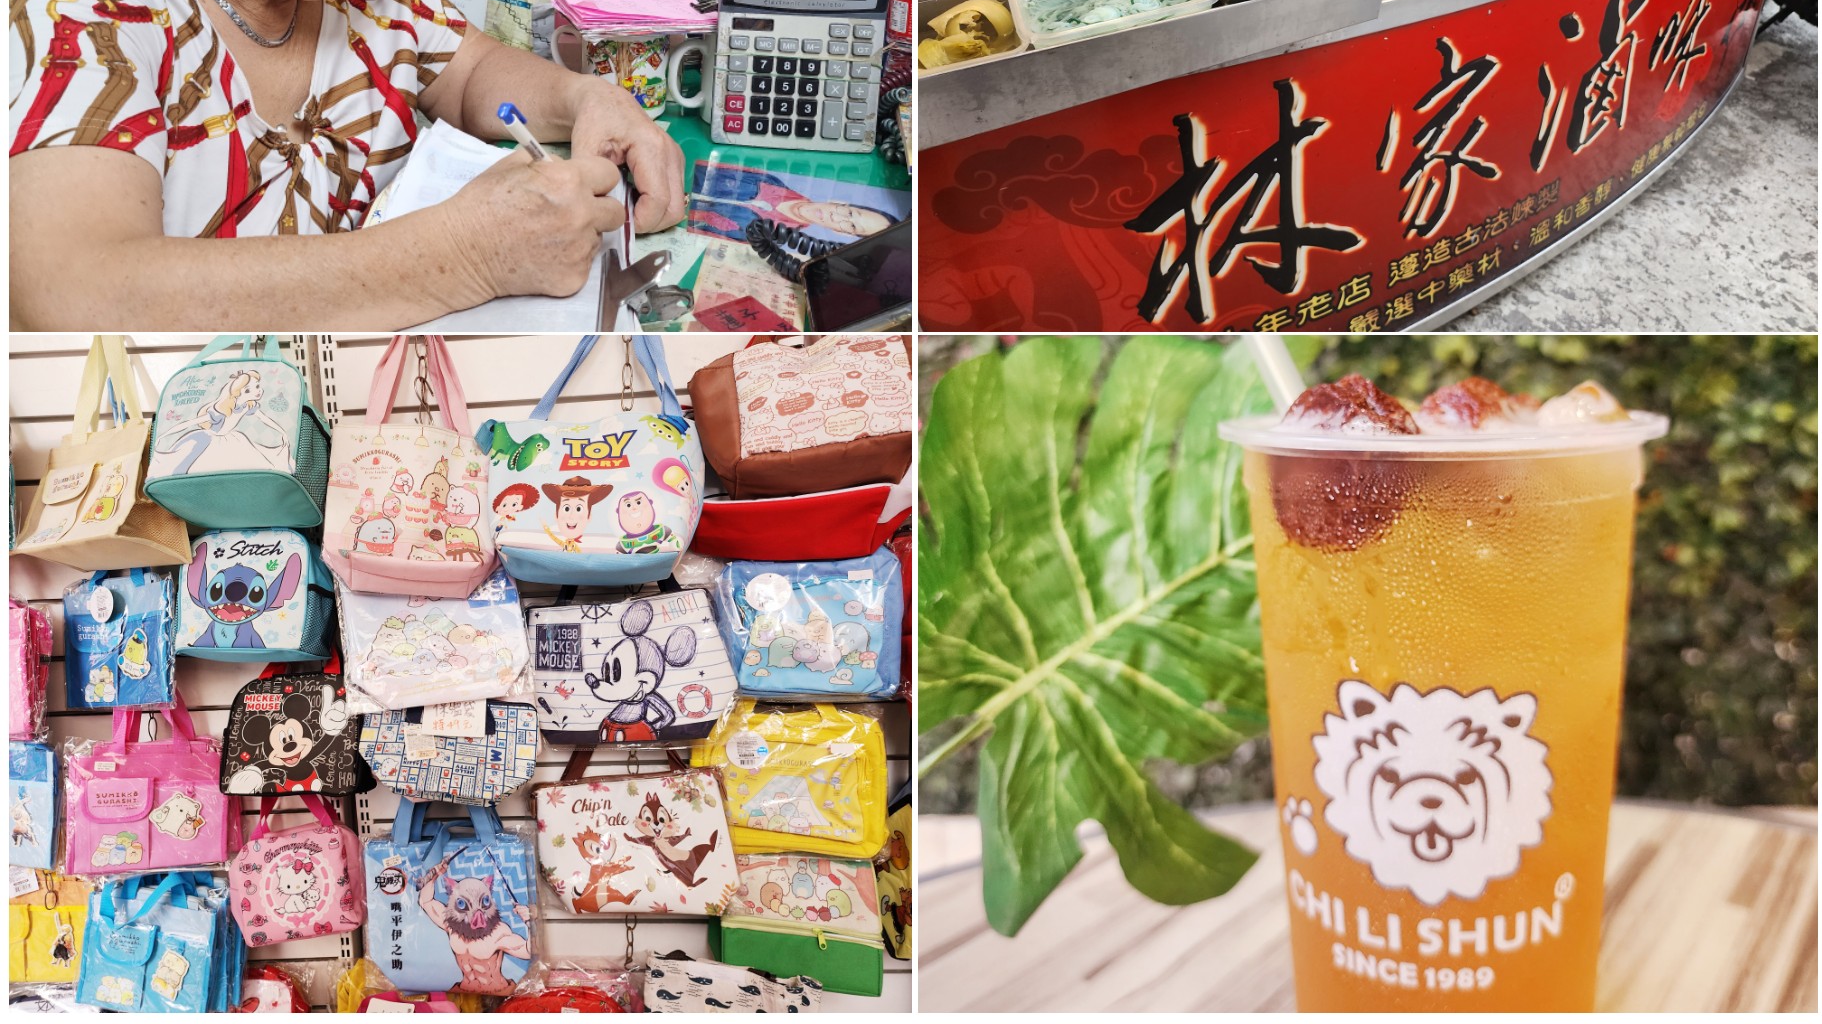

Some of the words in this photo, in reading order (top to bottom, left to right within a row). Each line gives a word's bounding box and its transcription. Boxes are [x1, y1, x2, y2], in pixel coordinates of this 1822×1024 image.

[759, 60, 768, 69] 7
[783, 62, 791, 71] 8
[808, 63, 816, 72] 9
[758, 81, 766, 90] 4
[782, 82, 790, 92] 5
[805, 83, 813, 93] 6
[729, 100, 743, 109] CE
[758, 101, 764, 111] 1
[780, 102, 788, 111] 2
[804, 104, 812, 114] 3
[727, 120, 741, 129] AC
[756, 122, 764, 131] 0
[776, 123, 789, 132] 00
[562, 429, 637, 459] TOY
[567, 458, 624, 468] STORY
[227, 540, 284, 559] Stitch
[661, 594, 700, 624] AHOY!
[557, 628, 578, 640] 1928
[538, 653, 580, 669] MOUSE
[244, 693, 283, 703] MICKEY
[245, 702, 281, 712] MOUSE
[572, 798, 612, 819] Chip'n
[596, 812, 630, 827] Dale
[1289, 868, 1346, 936] CHI
[1356, 906, 1401, 952] LI
[1416, 900, 1564, 956] SHUN
[1331, 942, 1418, 989] SINCE
[1424, 966, 1496, 991] 1989
